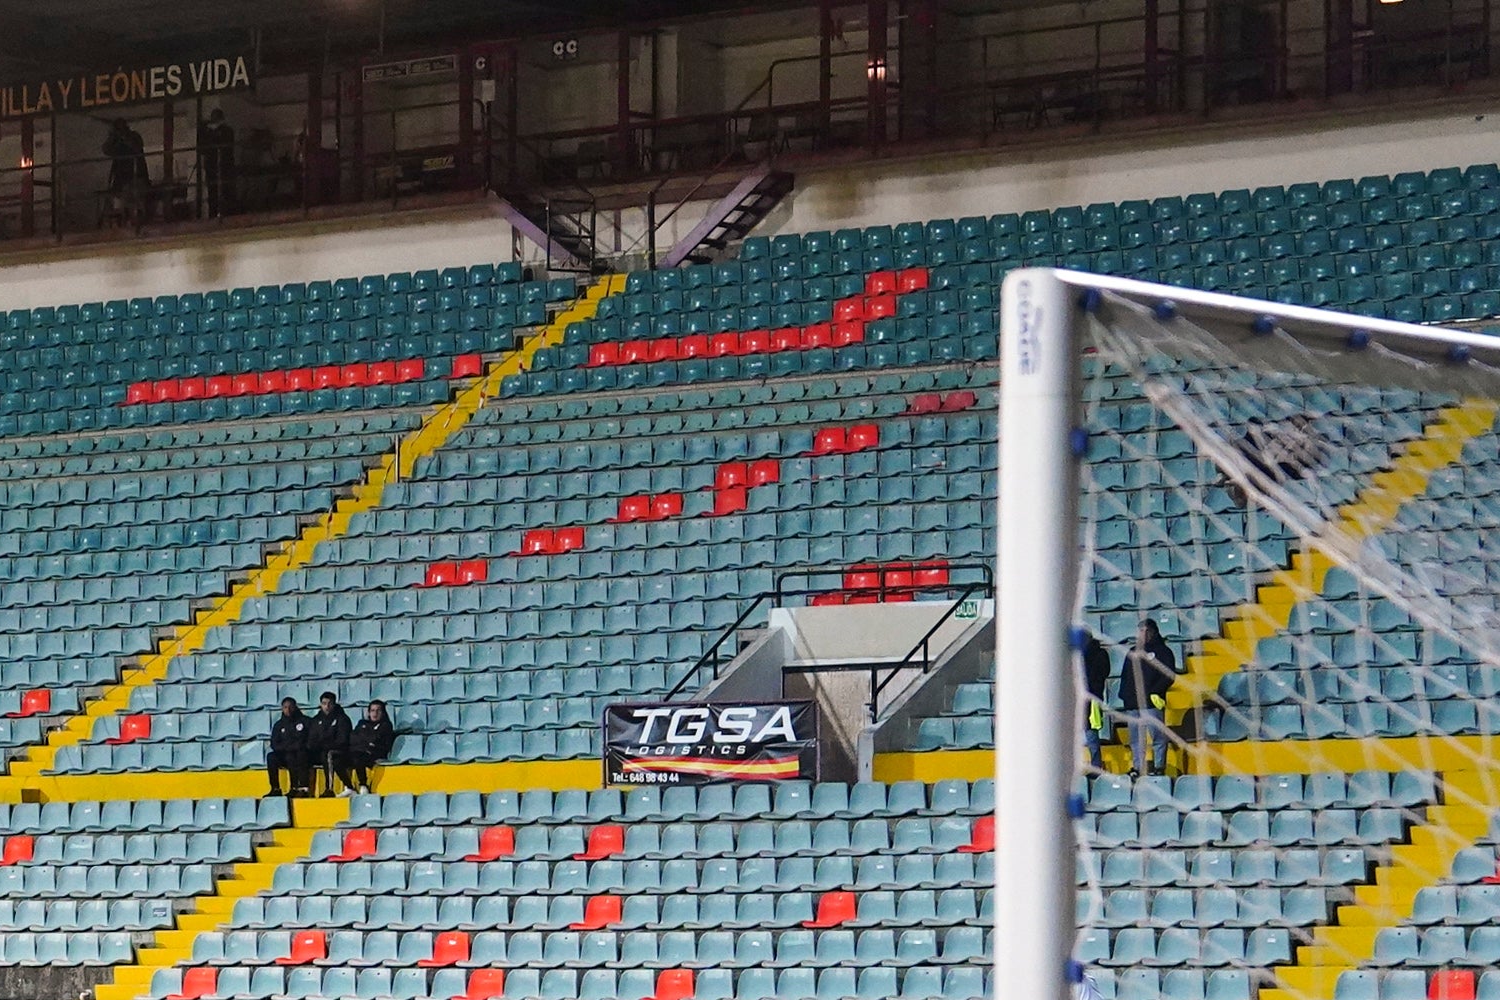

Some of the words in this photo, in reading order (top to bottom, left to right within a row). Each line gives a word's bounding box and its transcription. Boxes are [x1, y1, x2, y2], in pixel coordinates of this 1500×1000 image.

[58, 79, 73, 109] Y
[80, 66, 147, 107] LEÓN
[150, 62, 182, 98] ES
[189, 56, 250, 93] VIDA
[632, 706, 798, 744] TGSA
[625, 745, 747, 755] LOGISTICS
